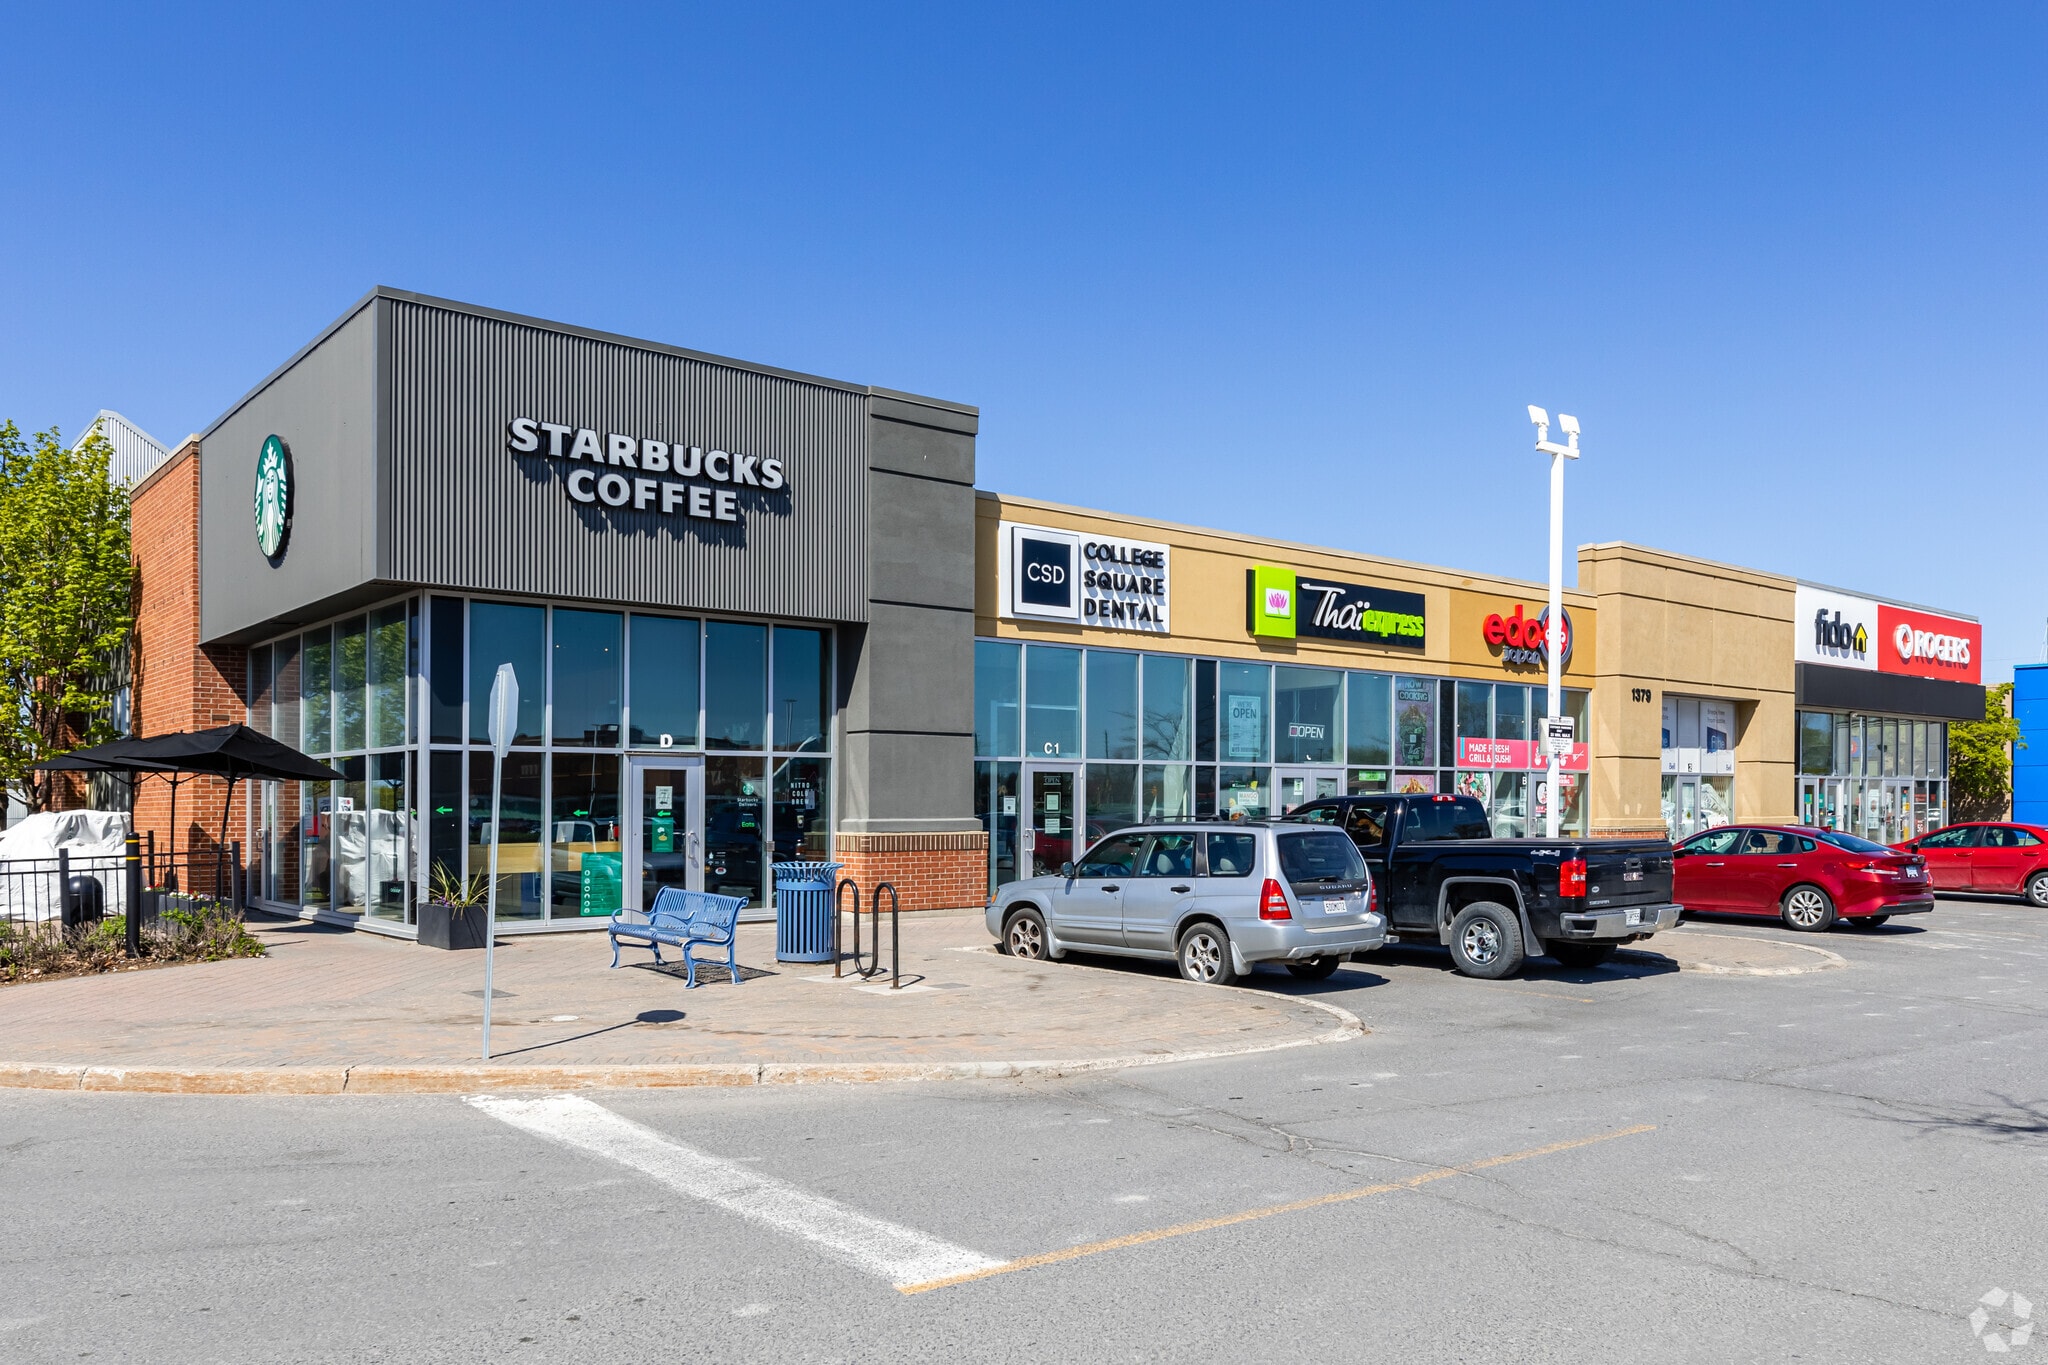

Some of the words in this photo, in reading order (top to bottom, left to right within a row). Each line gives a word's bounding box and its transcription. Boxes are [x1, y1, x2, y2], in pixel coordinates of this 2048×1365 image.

[508, 416, 784, 489] STARBUCKS
[565, 468, 738, 522] COFFEE
[1083, 541, 1164, 569] COLLEGE
[1027, 562, 1065, 584] CSD
[1083, 569, 1164, 596] SQUARE
[1083, 597, 1164, 623] DENTAL
[1362, 608, 1424, 638] express
[1482, 604, 1542, 649] edo
[1815, 608, 1852, 649] fido
[1502, 645, 1541, 665] japan
[1913, 629, 1971, 664] ROGERS
[1404, 680, 1423, 689] NOW
[1399, 690, 1428, 701] COOKING
[1631, 687, 1652, 704] 1379
[1233, 708, 1257, 719] OPEN
[660, 733, 673, 748] D
[1298, 726, 1324, 739] OPEN
[1044, 742, 1060, 755] C1
[1468, 743, 1487, 753] MADE
[1488, 745, 1510, 754] FRESH
[1468, 753, 1485, 763] GRILL
[1486, 754, 1492, 763] &
[1494, 754, 1511, 764] SUSHI
[1521, 776, 1528, 785] B
[1239, 792, 1258, 800] MANGO
